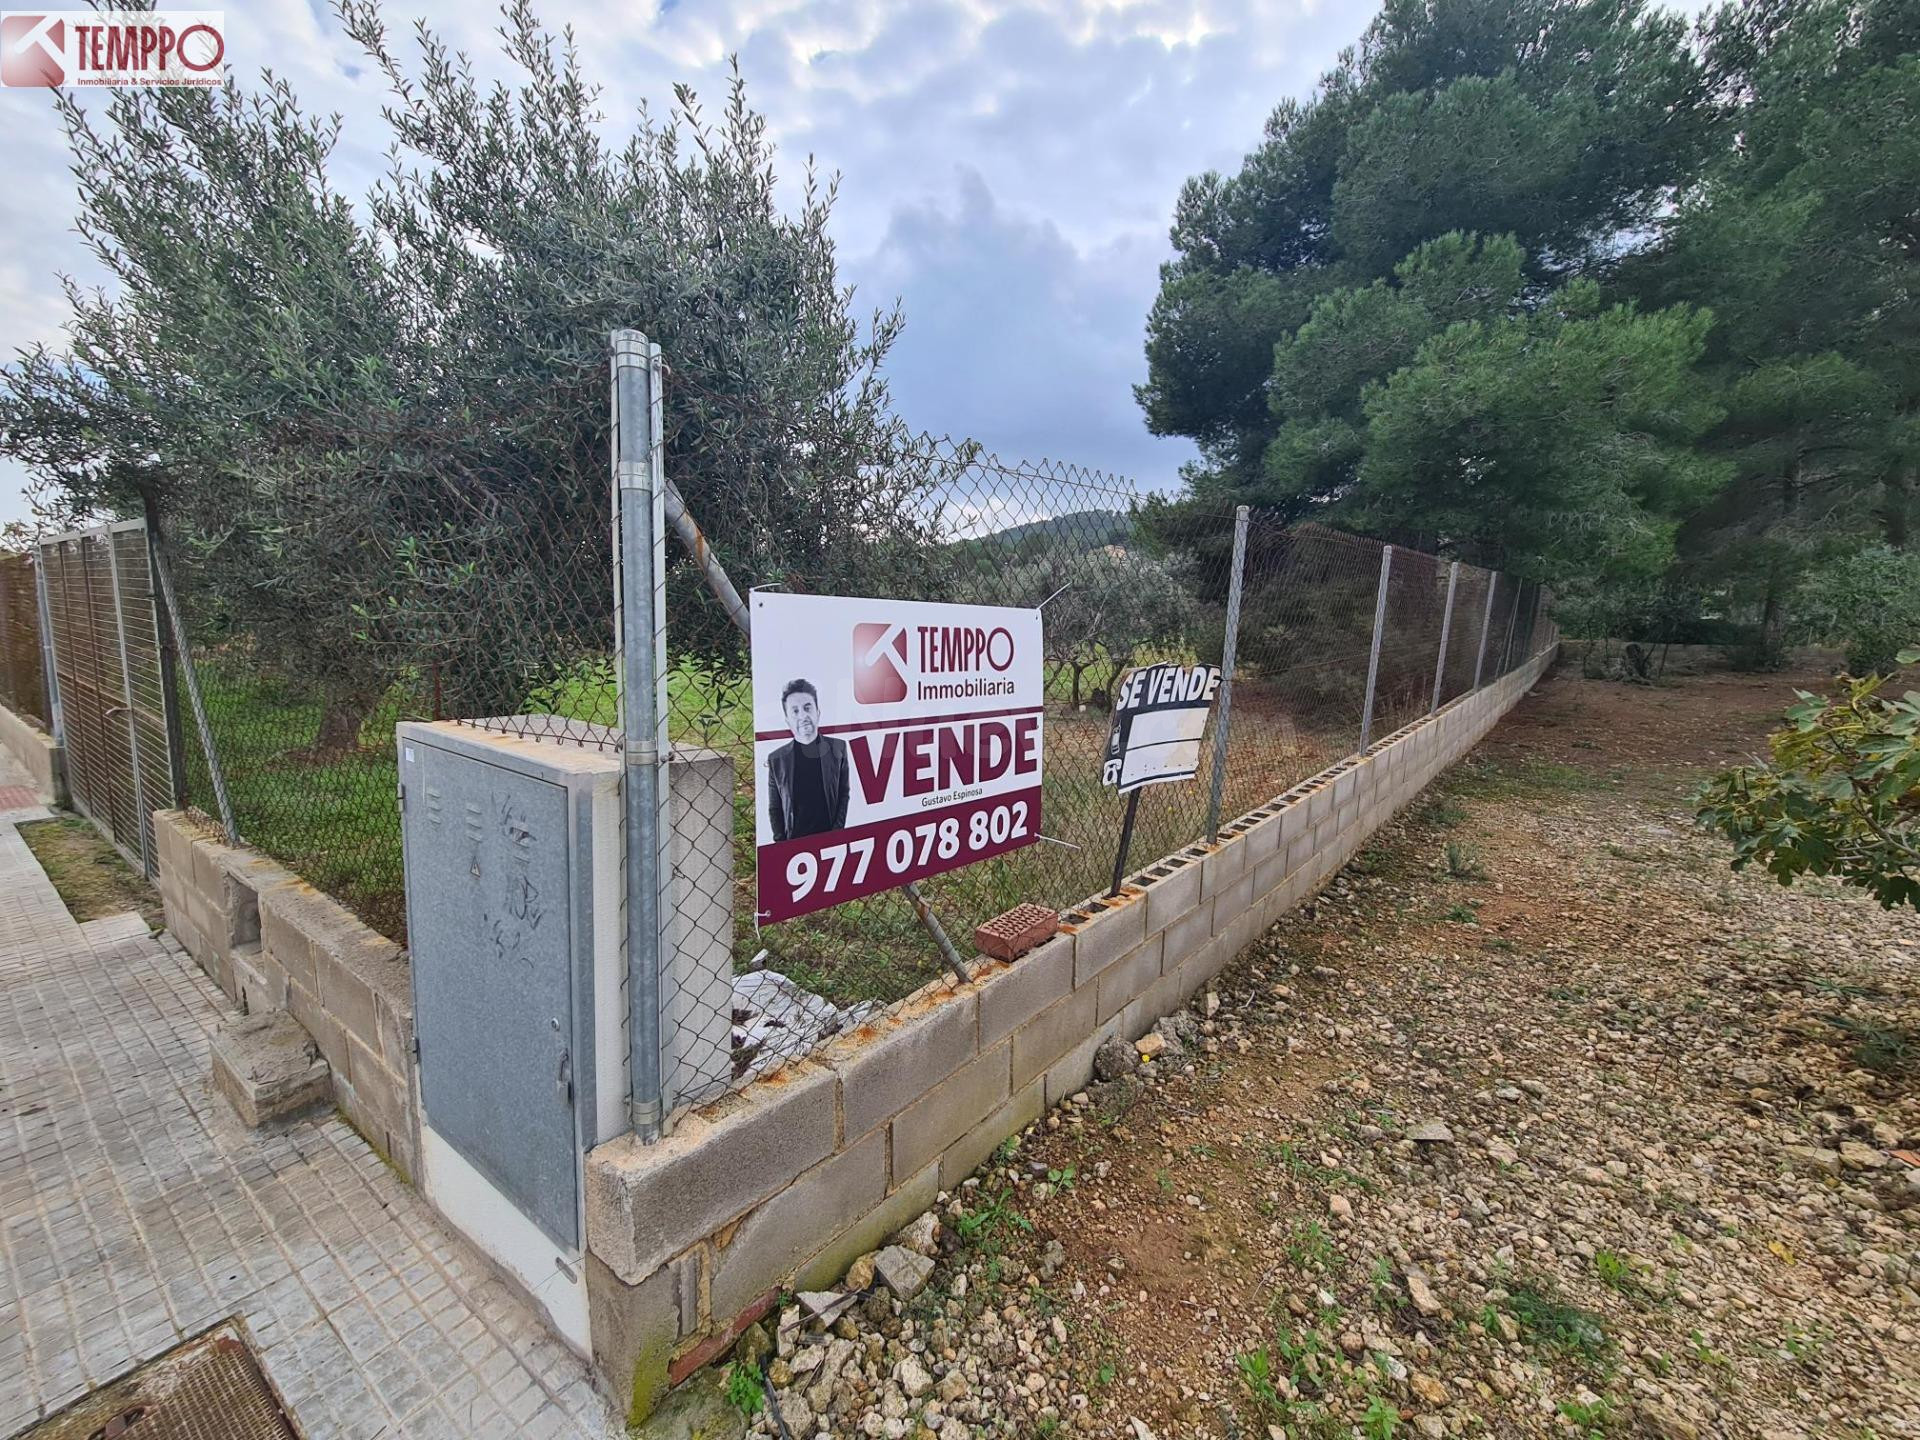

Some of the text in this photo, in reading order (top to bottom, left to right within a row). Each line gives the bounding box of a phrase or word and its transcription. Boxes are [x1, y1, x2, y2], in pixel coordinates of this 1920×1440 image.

[917, 626, 1014, 673] TEMPPO
[918, 677, 1014, 700] Immobiliaria
[1116, 666, 1221, 711] SE VENDE
[849, 717, 1038, 805] VENDE
[921, 788, 983, 808] Gustavo Espinosa
[786, 800, 1028, 903] 977 078 802
